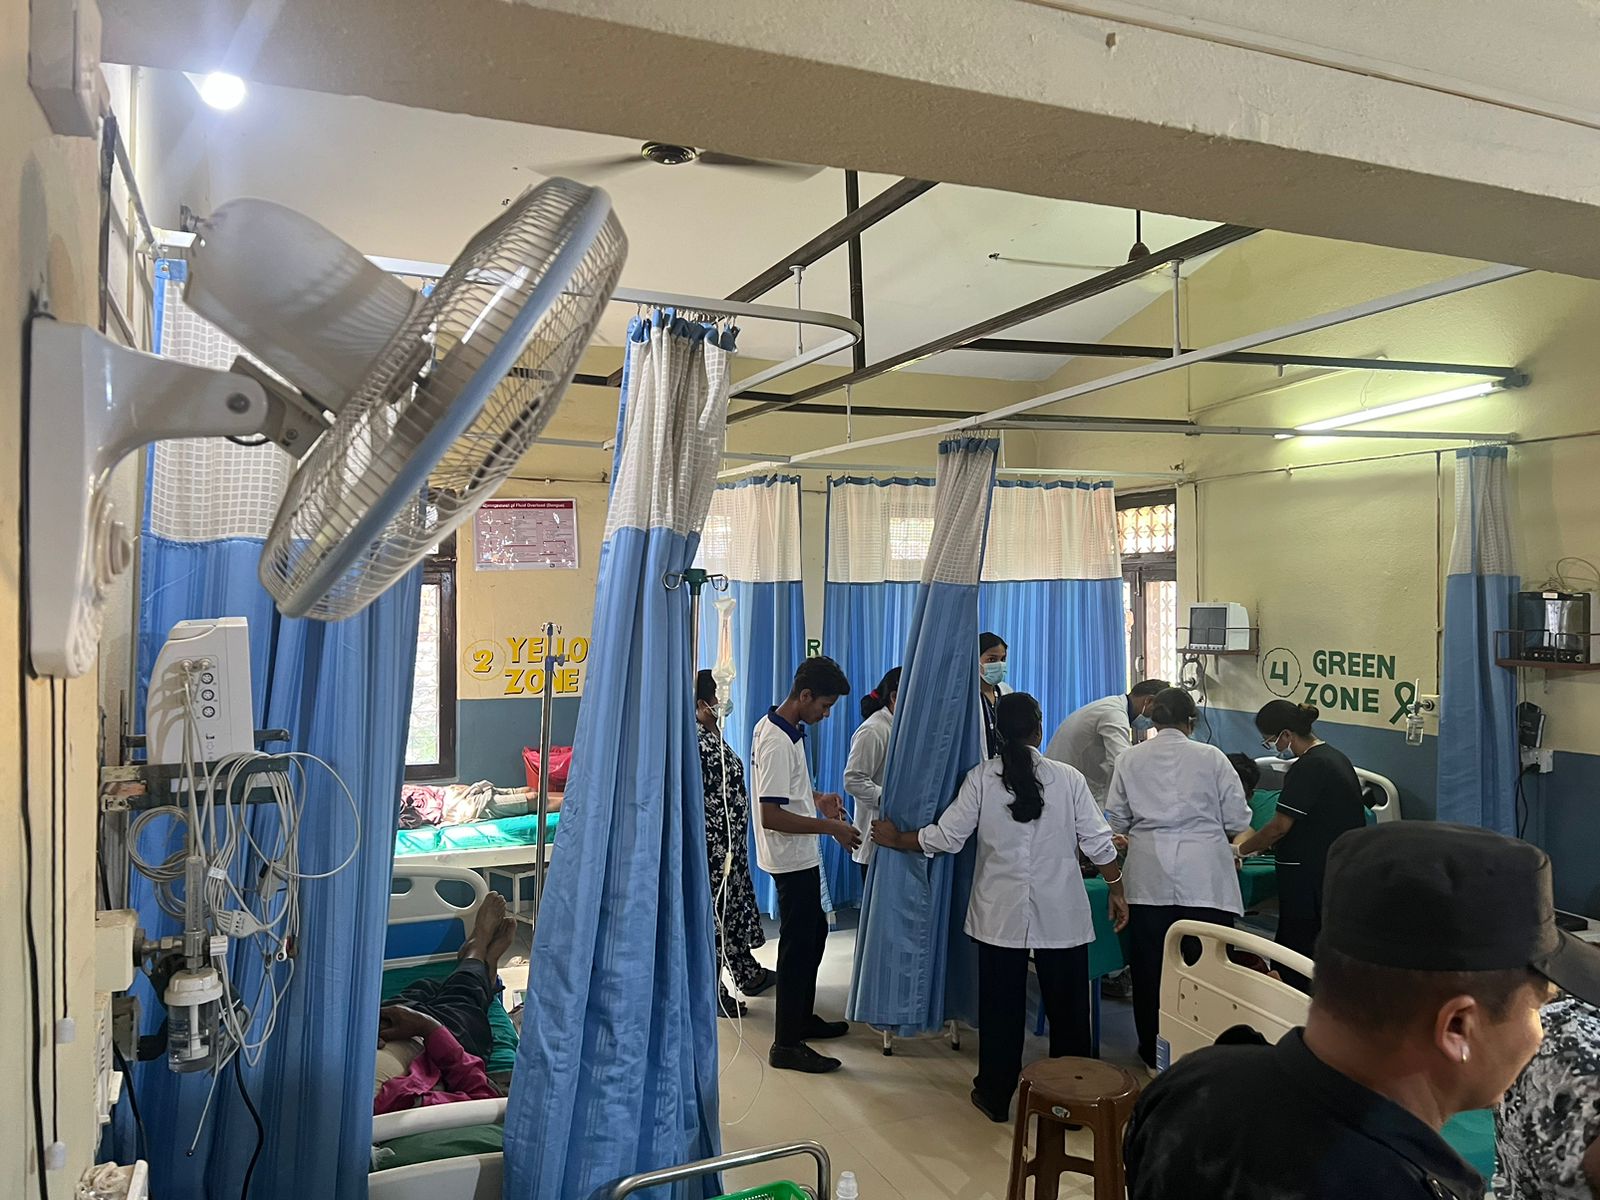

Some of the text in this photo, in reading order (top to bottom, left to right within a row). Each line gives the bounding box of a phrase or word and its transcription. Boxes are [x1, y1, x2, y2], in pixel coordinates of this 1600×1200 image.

[473, 649, 493, 673] 2
[505, 636, 592, 663] YELO
[1269, 661, 1289, 686] 4
[1313, 650, 1396, 680] GREEN
[504, 668, 580, 695] ZONE
[1304, 682, 1380, 713] ZONE
